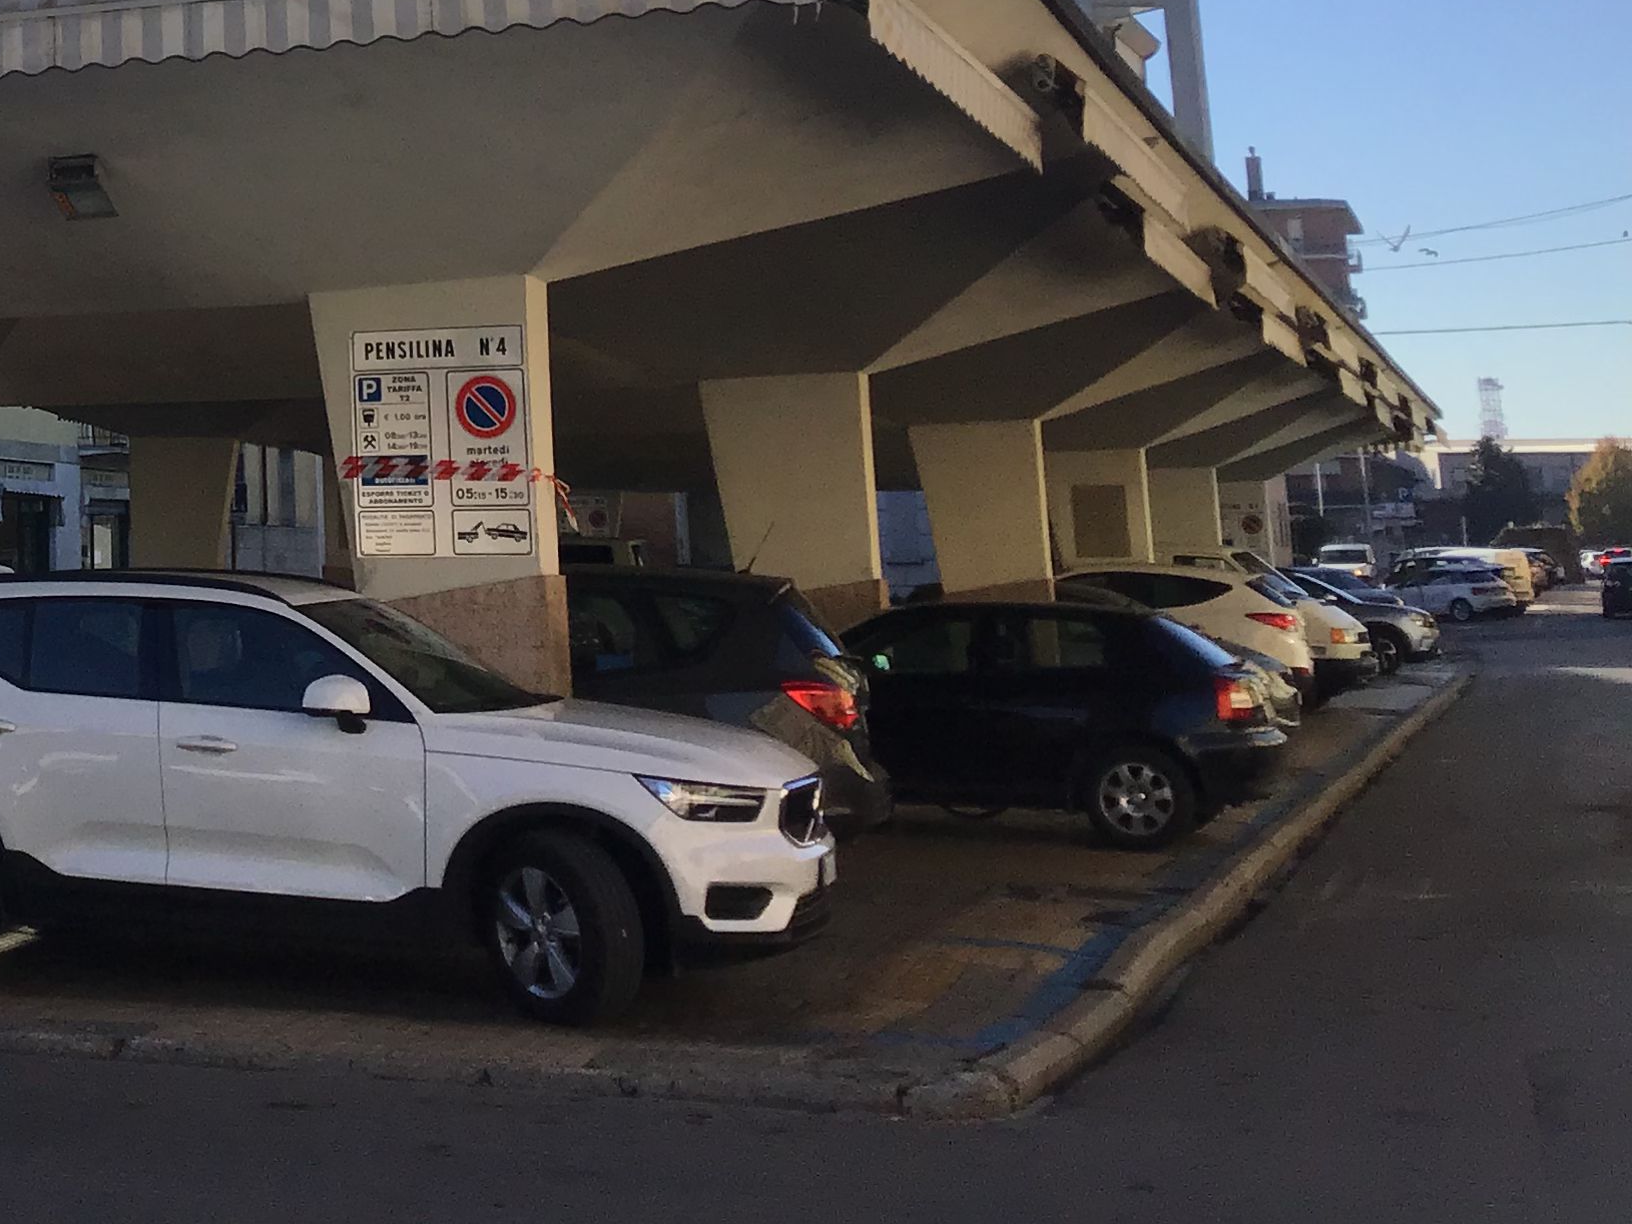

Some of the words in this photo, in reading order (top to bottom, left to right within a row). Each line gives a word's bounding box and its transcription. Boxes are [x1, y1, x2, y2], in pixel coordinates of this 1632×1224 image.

[365, 339, 455, 361] PENSILINA
[362, 380, 377, 400] P
[387, 384, 423, 393] TARIFFA
